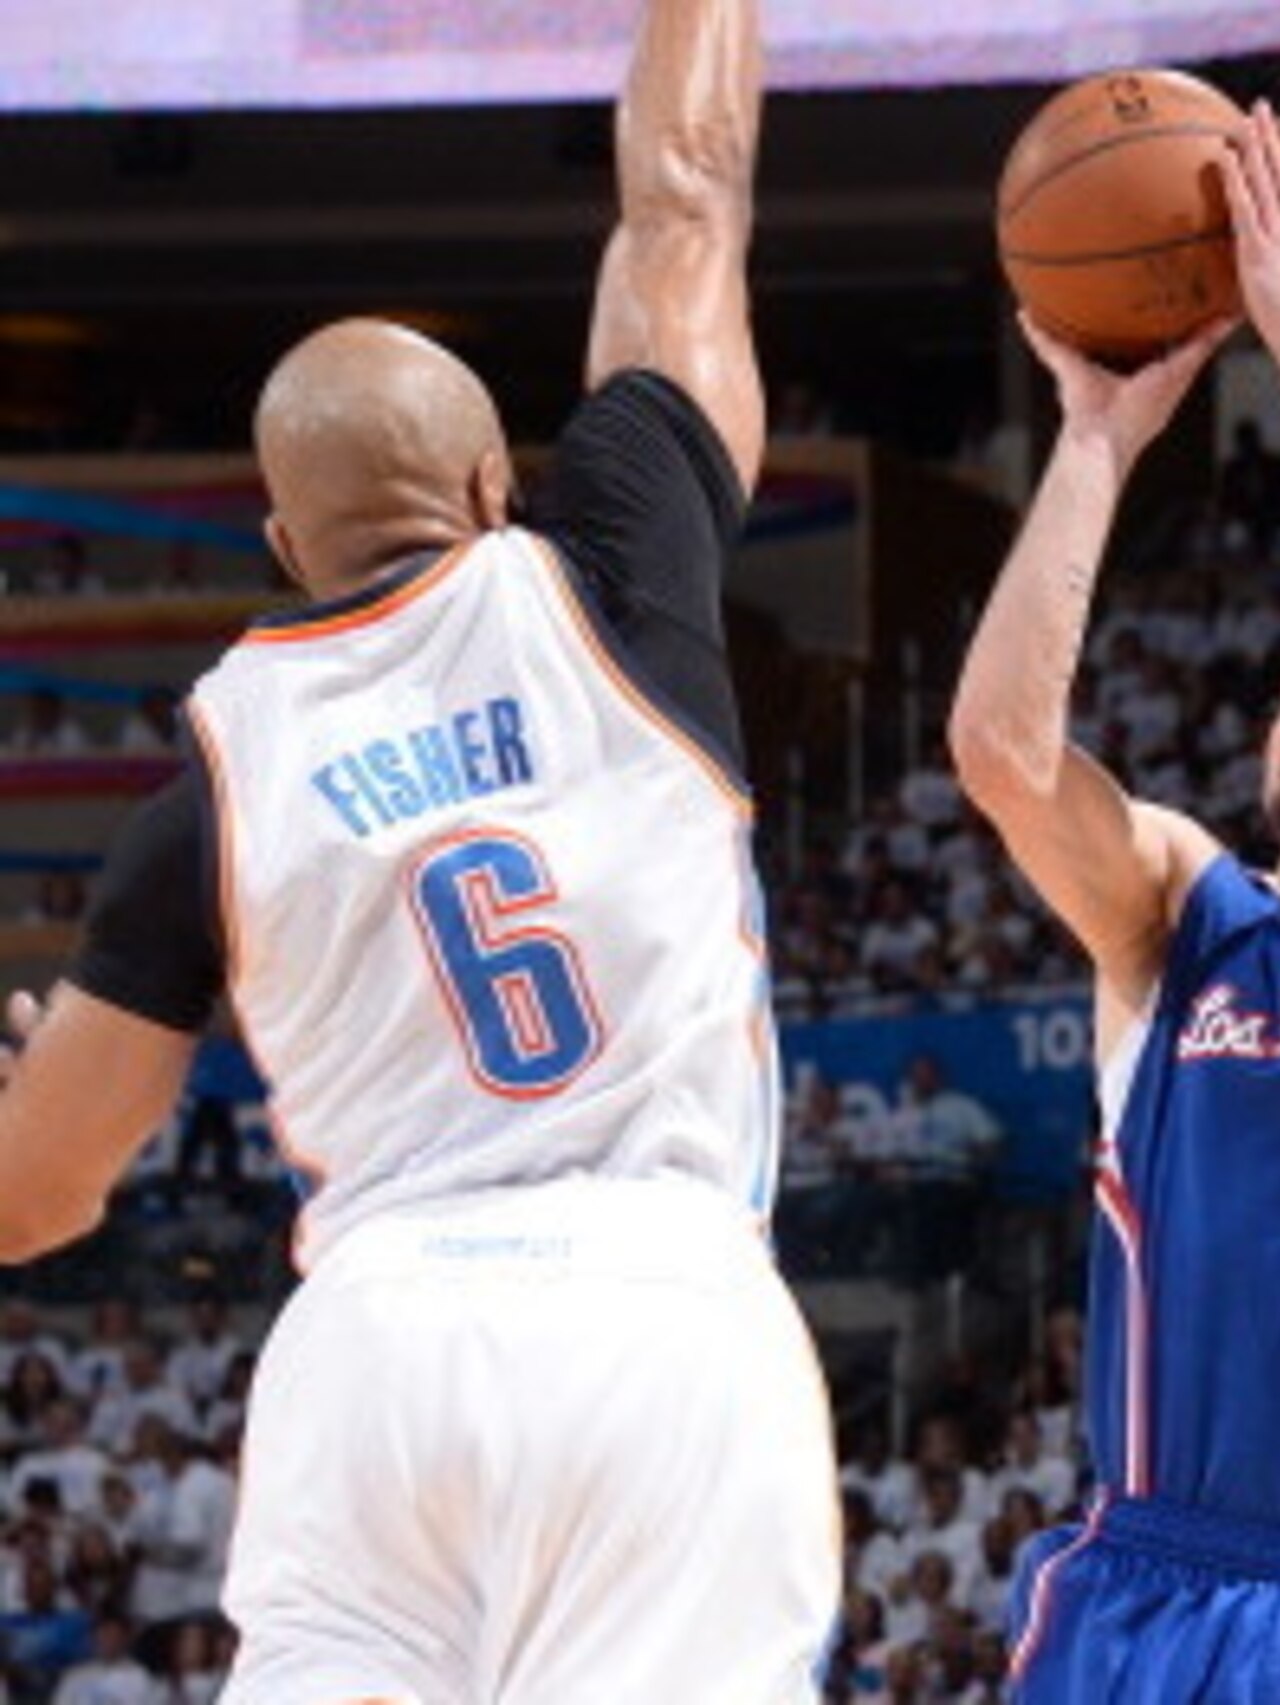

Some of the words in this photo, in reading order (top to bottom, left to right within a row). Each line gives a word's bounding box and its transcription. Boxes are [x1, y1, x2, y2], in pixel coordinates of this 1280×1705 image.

[310, 694, 533, 838] FISHER
[402, 825, 605, 1102] 6
[1177, 983, 1270, 1062] Los
